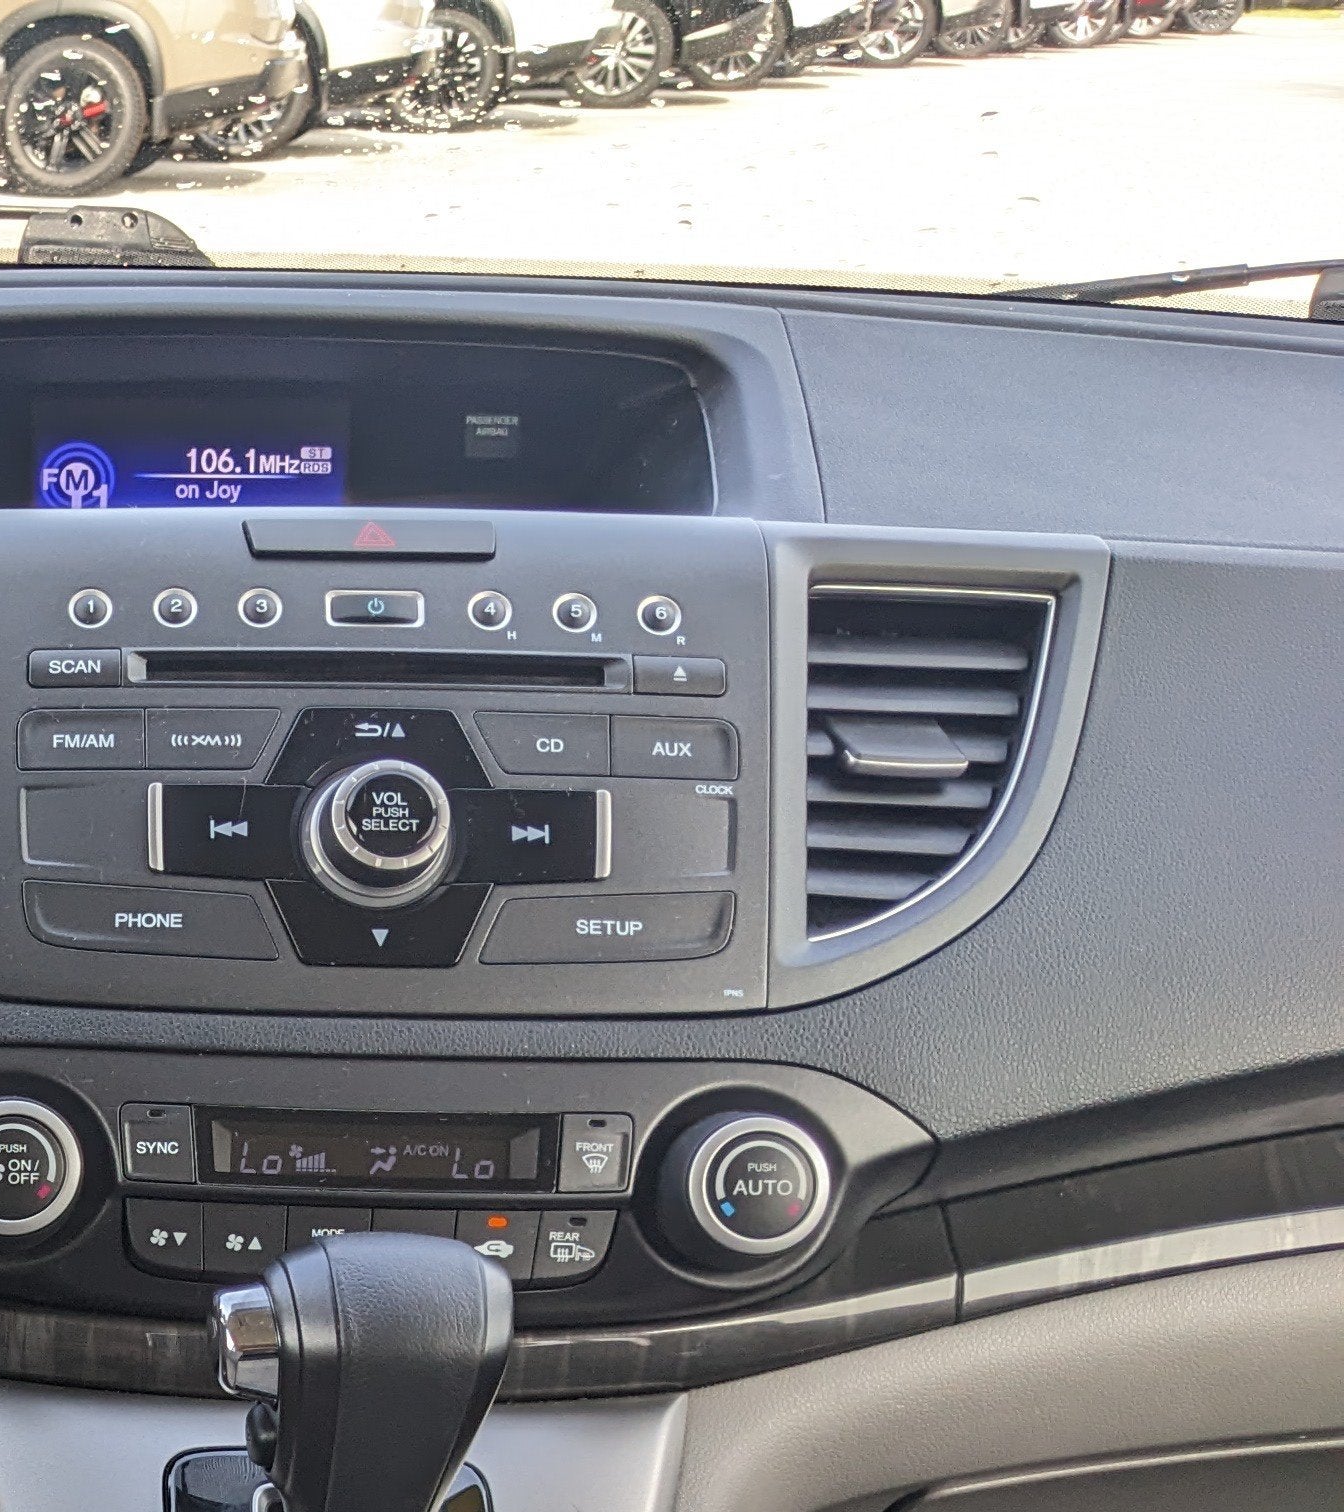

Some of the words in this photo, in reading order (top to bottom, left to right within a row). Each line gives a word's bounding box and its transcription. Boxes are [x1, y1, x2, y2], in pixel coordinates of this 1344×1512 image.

[175, 483, 200, 499] on
[205, 481, 242, 503] Joy
[86, 600, 95, 613] 1
[170, 599, 183, 613] 2
[255, 599, 268, 613] 3
[483, 603, 496, 616] 4
[570, 604, 582, 617] 5
[655, 606, 667, 619] 6
[507, 630, 517, 640] H
[591, 633, 602, 643] M
[676, 636, 686, 645] R
[48, 659, 102, 674] SCAN
[52, 733, 115, 749] FM/AM
[535, 738, 564, 753] CD
[652, 741, 692, 757] AUX
[695, 784, 733, 795] CLOCK
[371, 791, 408, 806] VOL
[372, 807, 409, 818] PUSH
[361, 819, 420, 831] SELECT
[114, 912, 183, 928] PHONE
[575, 919, 643, 936] SETUP
[135, 1141, 179, 1155] SYNC
[403, 1144, 427, 1156] A/C
[429, 1144, 449, 1157] ON
[575, 1142, 614, 1152] FRONT
[240, 1141, 283, 1175] Lo
[452, 1147, 495, 1179] Lo
[747, 1162, 777, 1172] PUSH
[7, 1172, 40, 1185] OFF
[732, 1179, 793, 1195] AUTO
[549, 1231, 580, 1242] REAR
